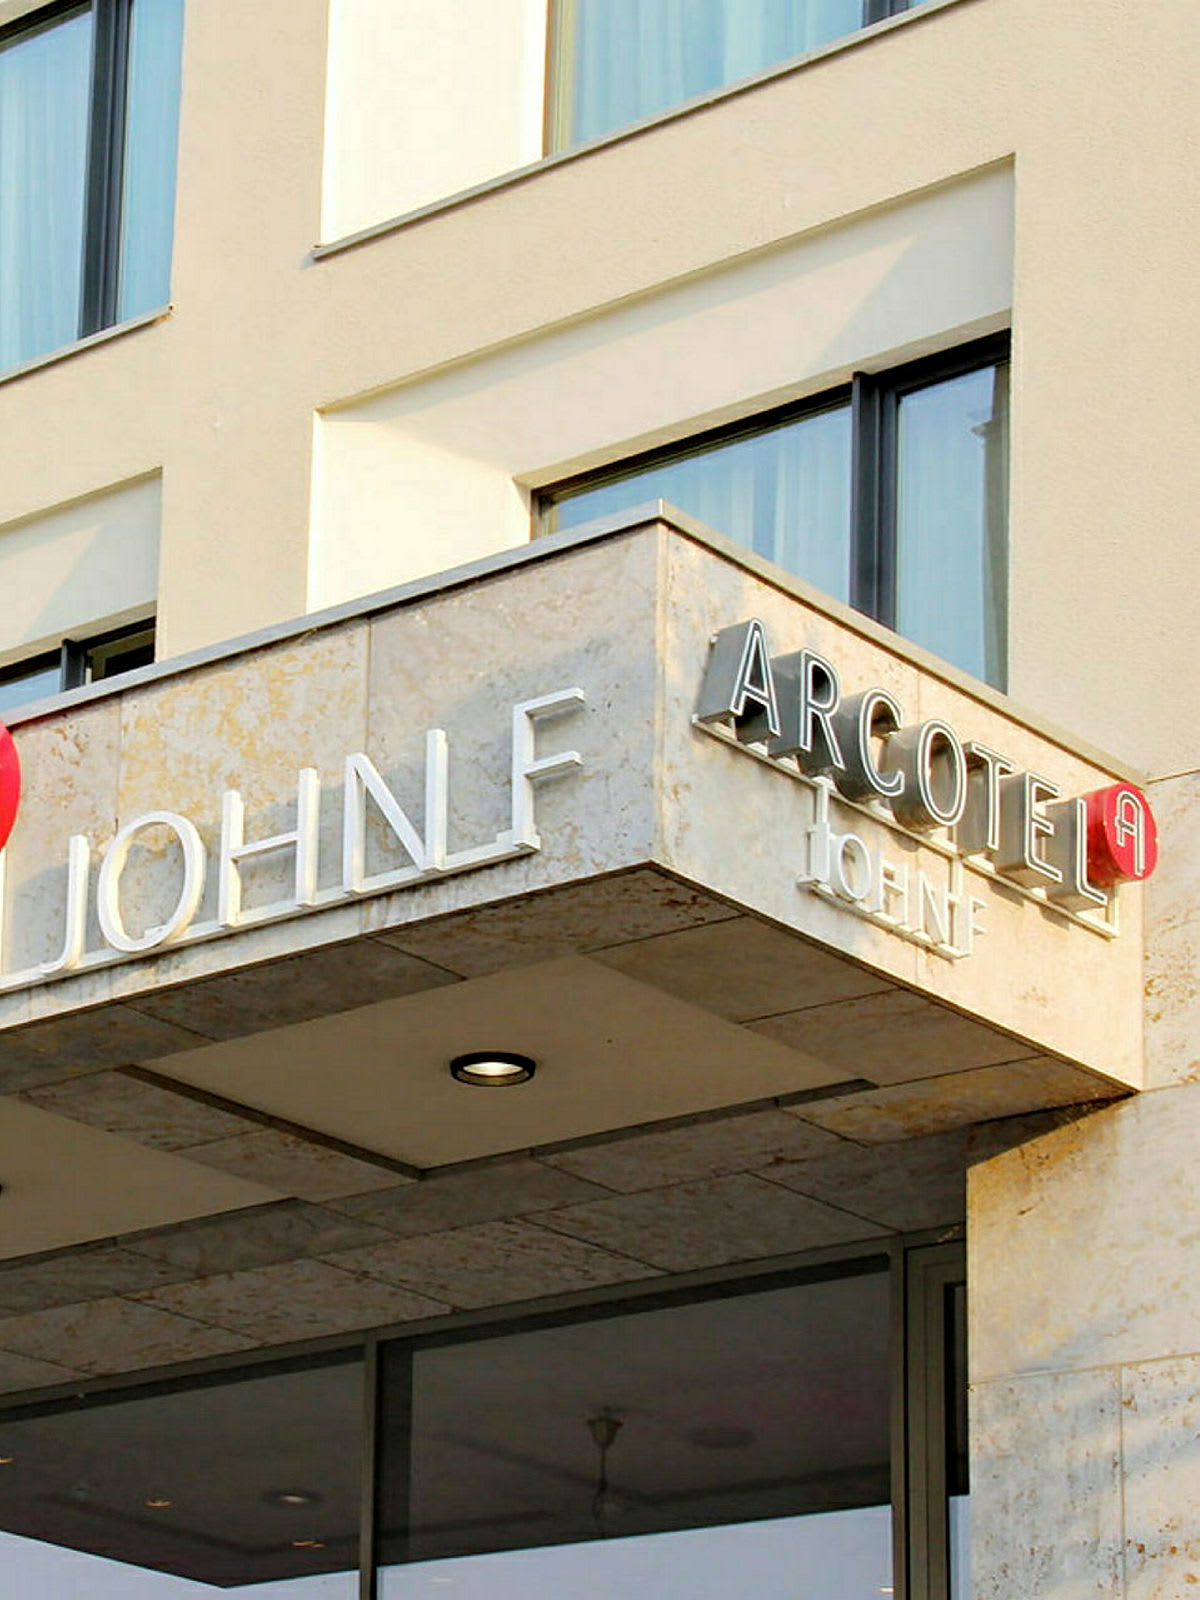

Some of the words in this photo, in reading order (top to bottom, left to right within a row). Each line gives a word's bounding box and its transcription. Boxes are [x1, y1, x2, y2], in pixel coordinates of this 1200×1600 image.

[41, 729, 450, 975] JOHN
[511, 688, 586, 853] F
[728, 617, 1108, 906] ARCOTEL
